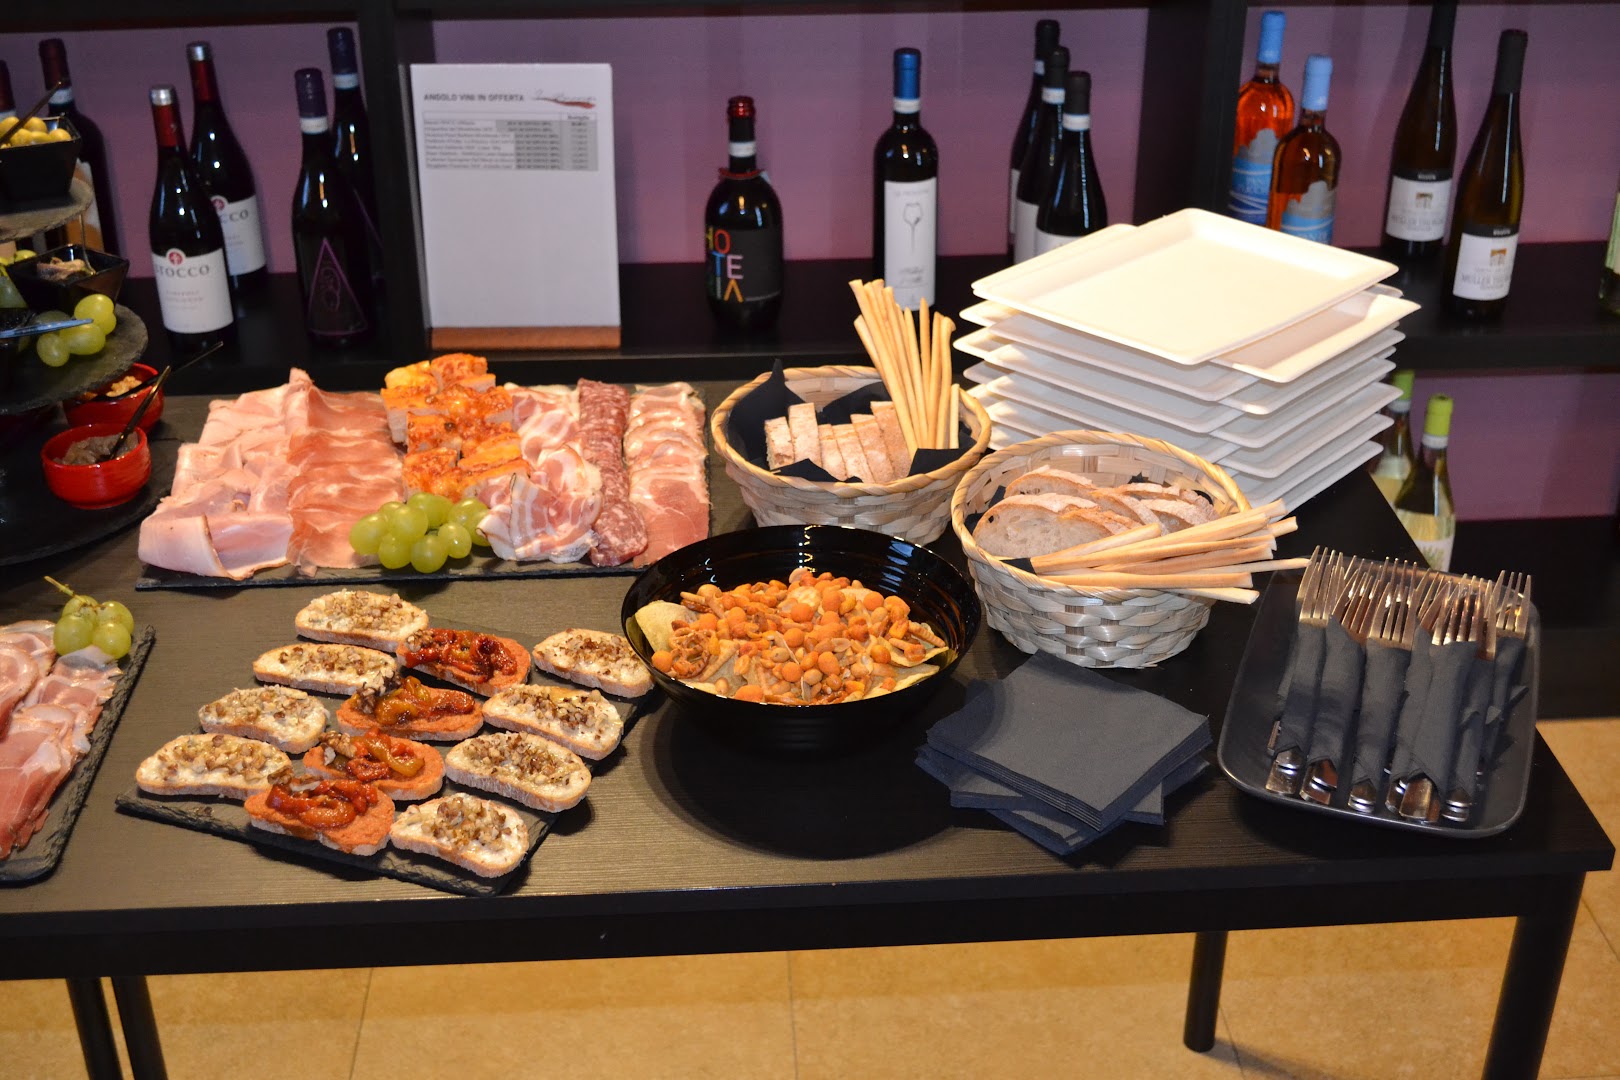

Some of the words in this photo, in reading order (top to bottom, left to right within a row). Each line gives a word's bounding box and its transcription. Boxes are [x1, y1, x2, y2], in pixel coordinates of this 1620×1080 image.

[423, 93, 458, 102] ANGOLO
[460, 93, 475, 102] VINI
[478, 93, 486, 102] IN
[487, 93, 524, 102] OFFERTA
